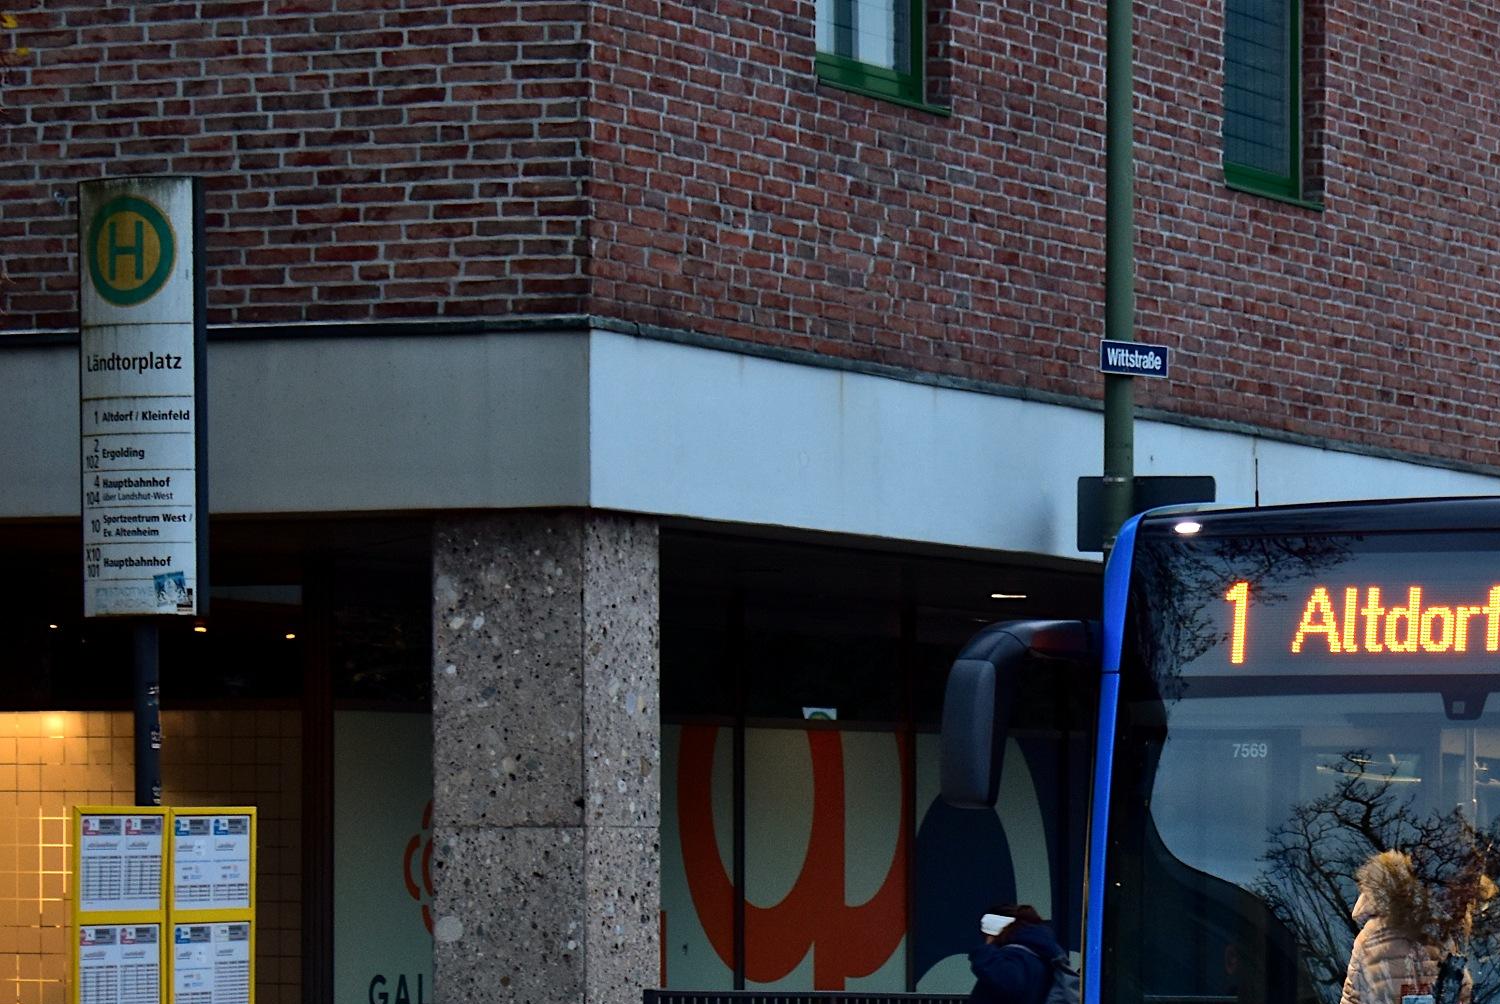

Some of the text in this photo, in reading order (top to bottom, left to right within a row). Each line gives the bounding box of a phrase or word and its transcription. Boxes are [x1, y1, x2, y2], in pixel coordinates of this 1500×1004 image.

[109, 221, 143, 280] H
[87, 351, 182, 374] Ländtorplatz
[1107, 347, 1162, 370] Wittstraße
[94, 411, 99, 424] 1
[102, 411, 133, 422] Altdorf
[141, 410, 190, 421] Kleinfeld
[94, 439, 99, 453] 2
[102, 448, 145, 460] Ergolding
[86, 455, 99, 469] 102
[94, 475, 100, 488] 4
[102, 477, 170, 490] Hauptbahnhof
[86, 491, 100, 505] 104
[103, 492, 174, 501] über Landshut-West
[91, 519, 101, 533] 10
[103, 515, 160, 526] Sportzentrum
[162, 513, 187, 522] West
[103, 528, 160, 537] Ev. Altenheim
[86, 548, 101, 562] X10
[103, 556, 171, 569] Hauptbahnhof
[87, 564, 100, 578] 101
[1226, 582, 1250, 664] 1
[1232, 743, 1268, 758] 7569
